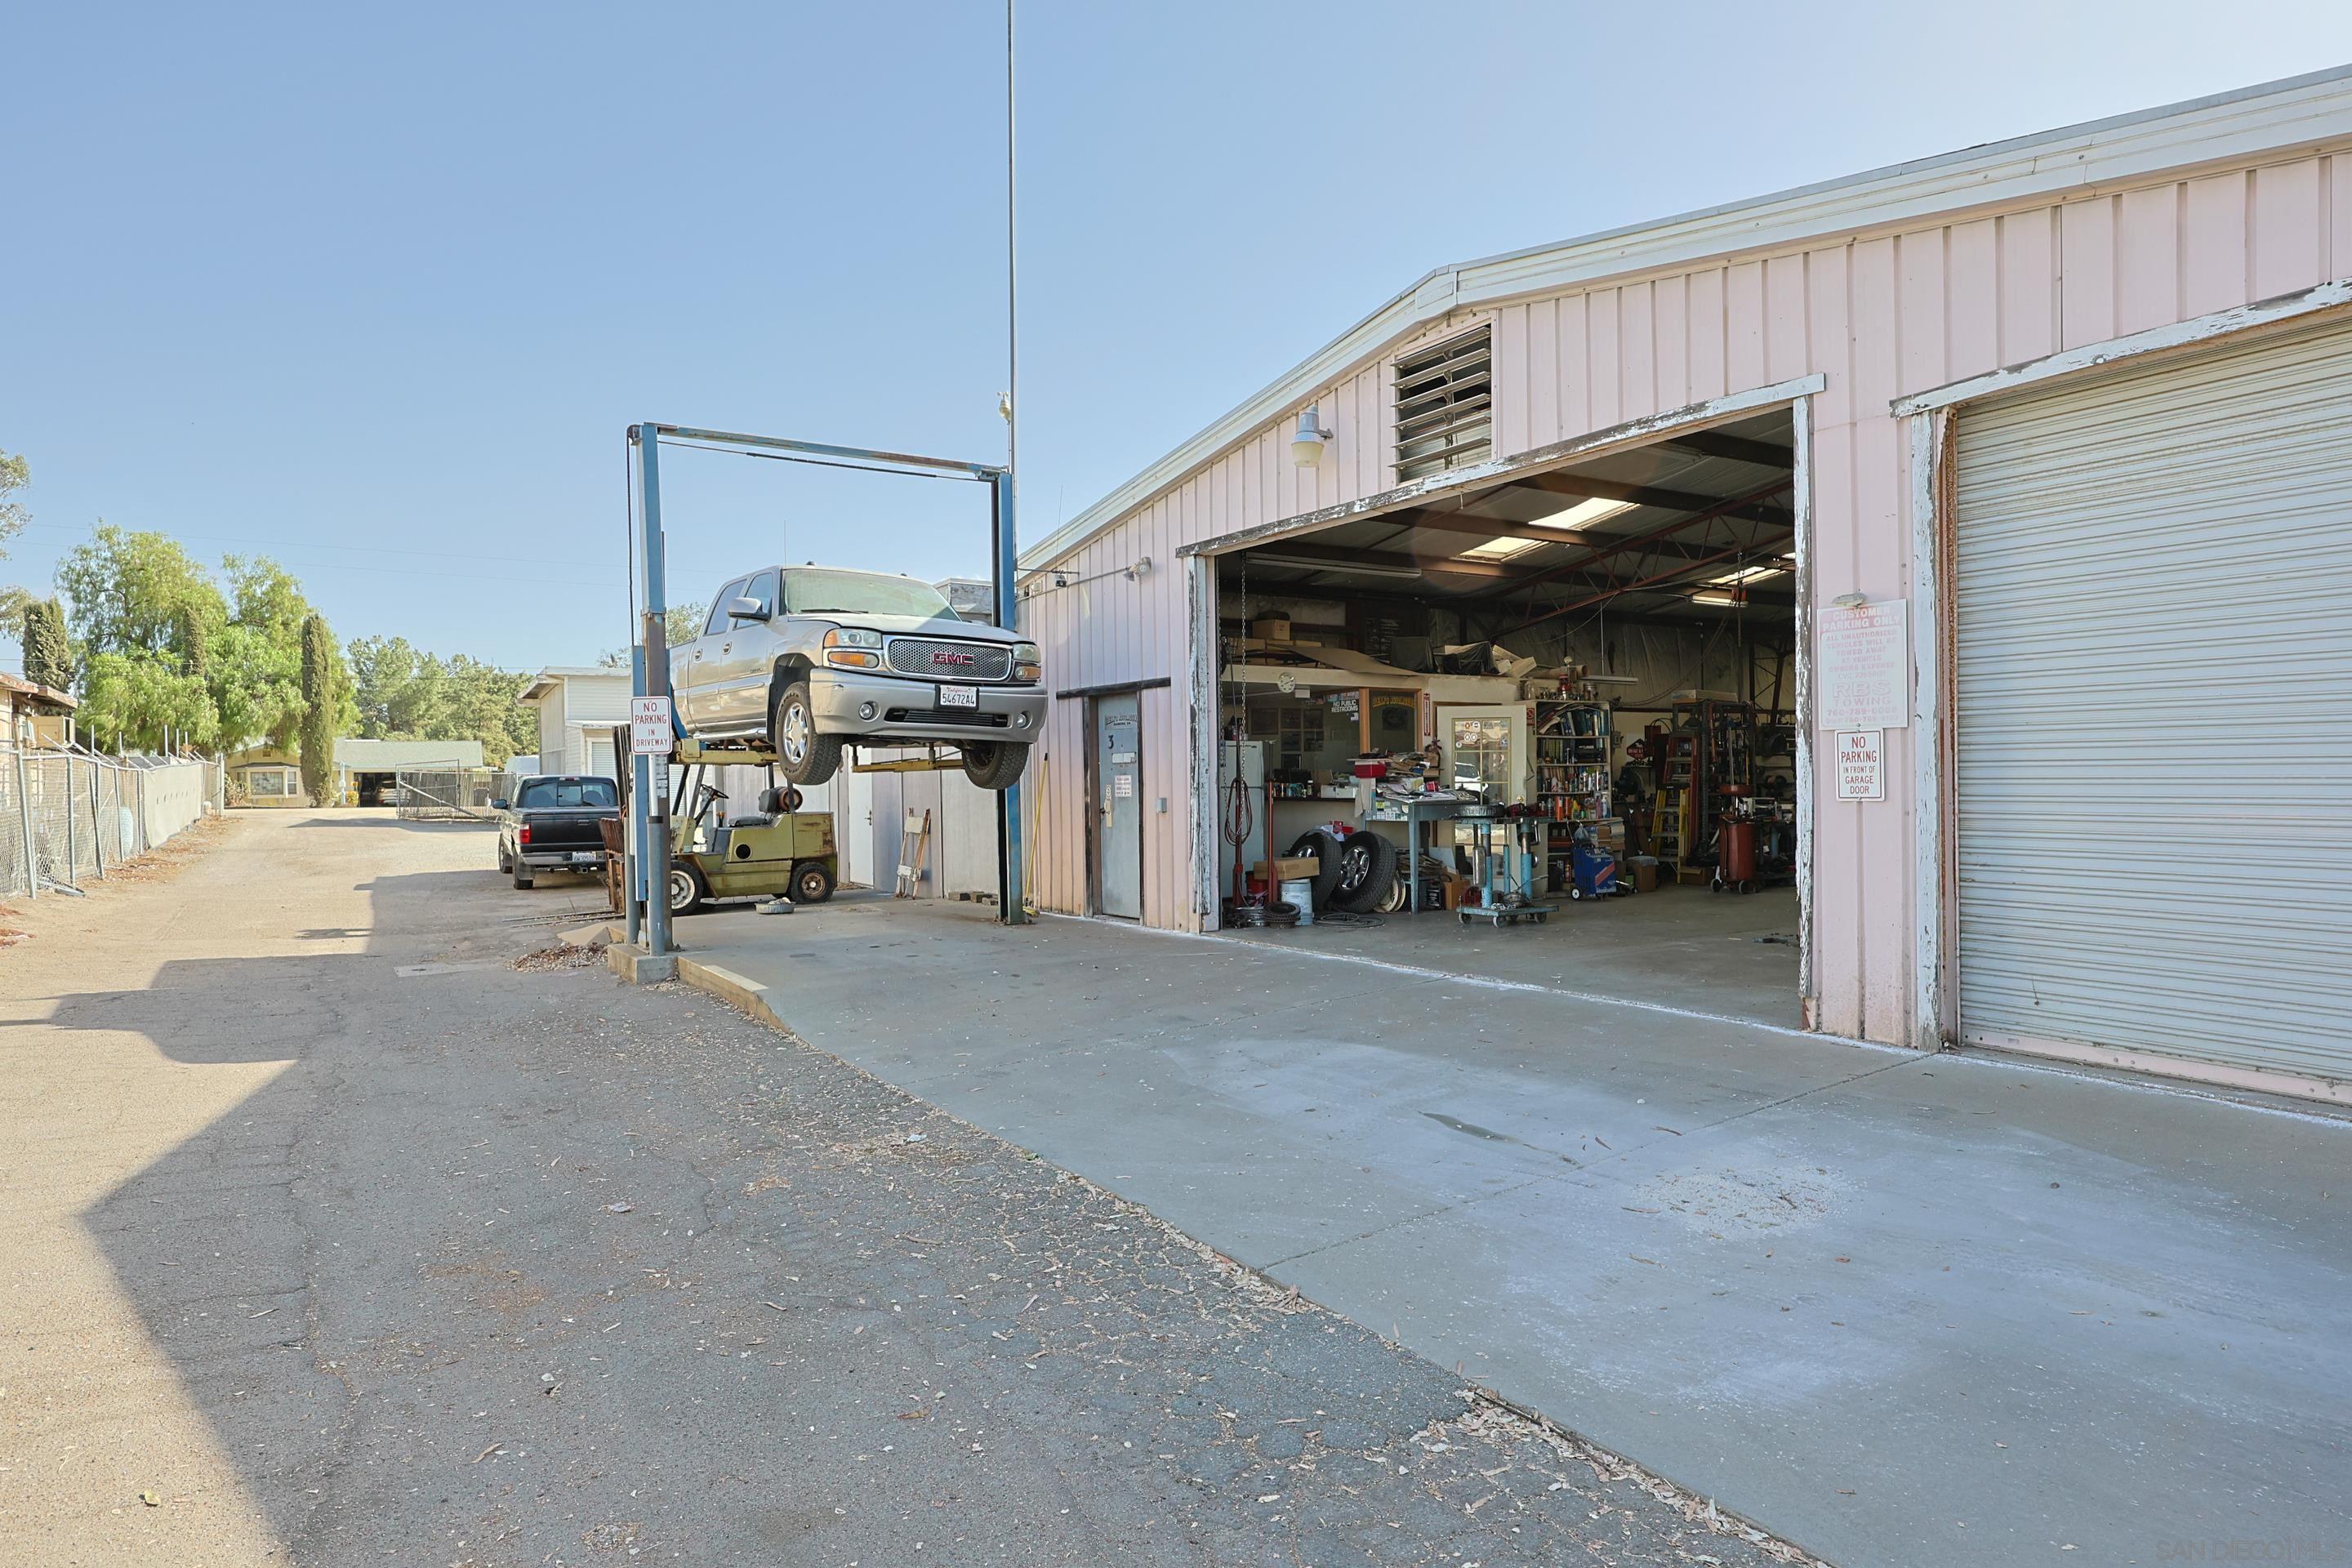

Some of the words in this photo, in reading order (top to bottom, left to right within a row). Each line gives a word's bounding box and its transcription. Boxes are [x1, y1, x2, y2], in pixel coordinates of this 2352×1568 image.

[1833, 606, 1891, 621] CUSTOMER
[1822, 618, 1869, 632] PARKING
[1873, 614, 1901, 626] ONLY
[1865, 646, 1886, 654] AWAY
[932, 652, 974, 666] GMC
[1832, 679, 1891, 699] RBS
[942, 693, 975, 706] 54672A4
[1833, 697, 1891, 707] TOWING
[644, 702, 657, 712] NO
[635, 715, 667, 724] PARKING
[648, 728, 655, 737] IN
[636, 738, 668, 746] DRIVEWAY
[1851, 737, 1866, 749] NO
[1841, 751, 1877, 763] PARKING
[1869, 765, 1876, 773] OF
[1845, 776, 1874, 784] GARAGE
[1850, 786, 1869, 795] DOOR
